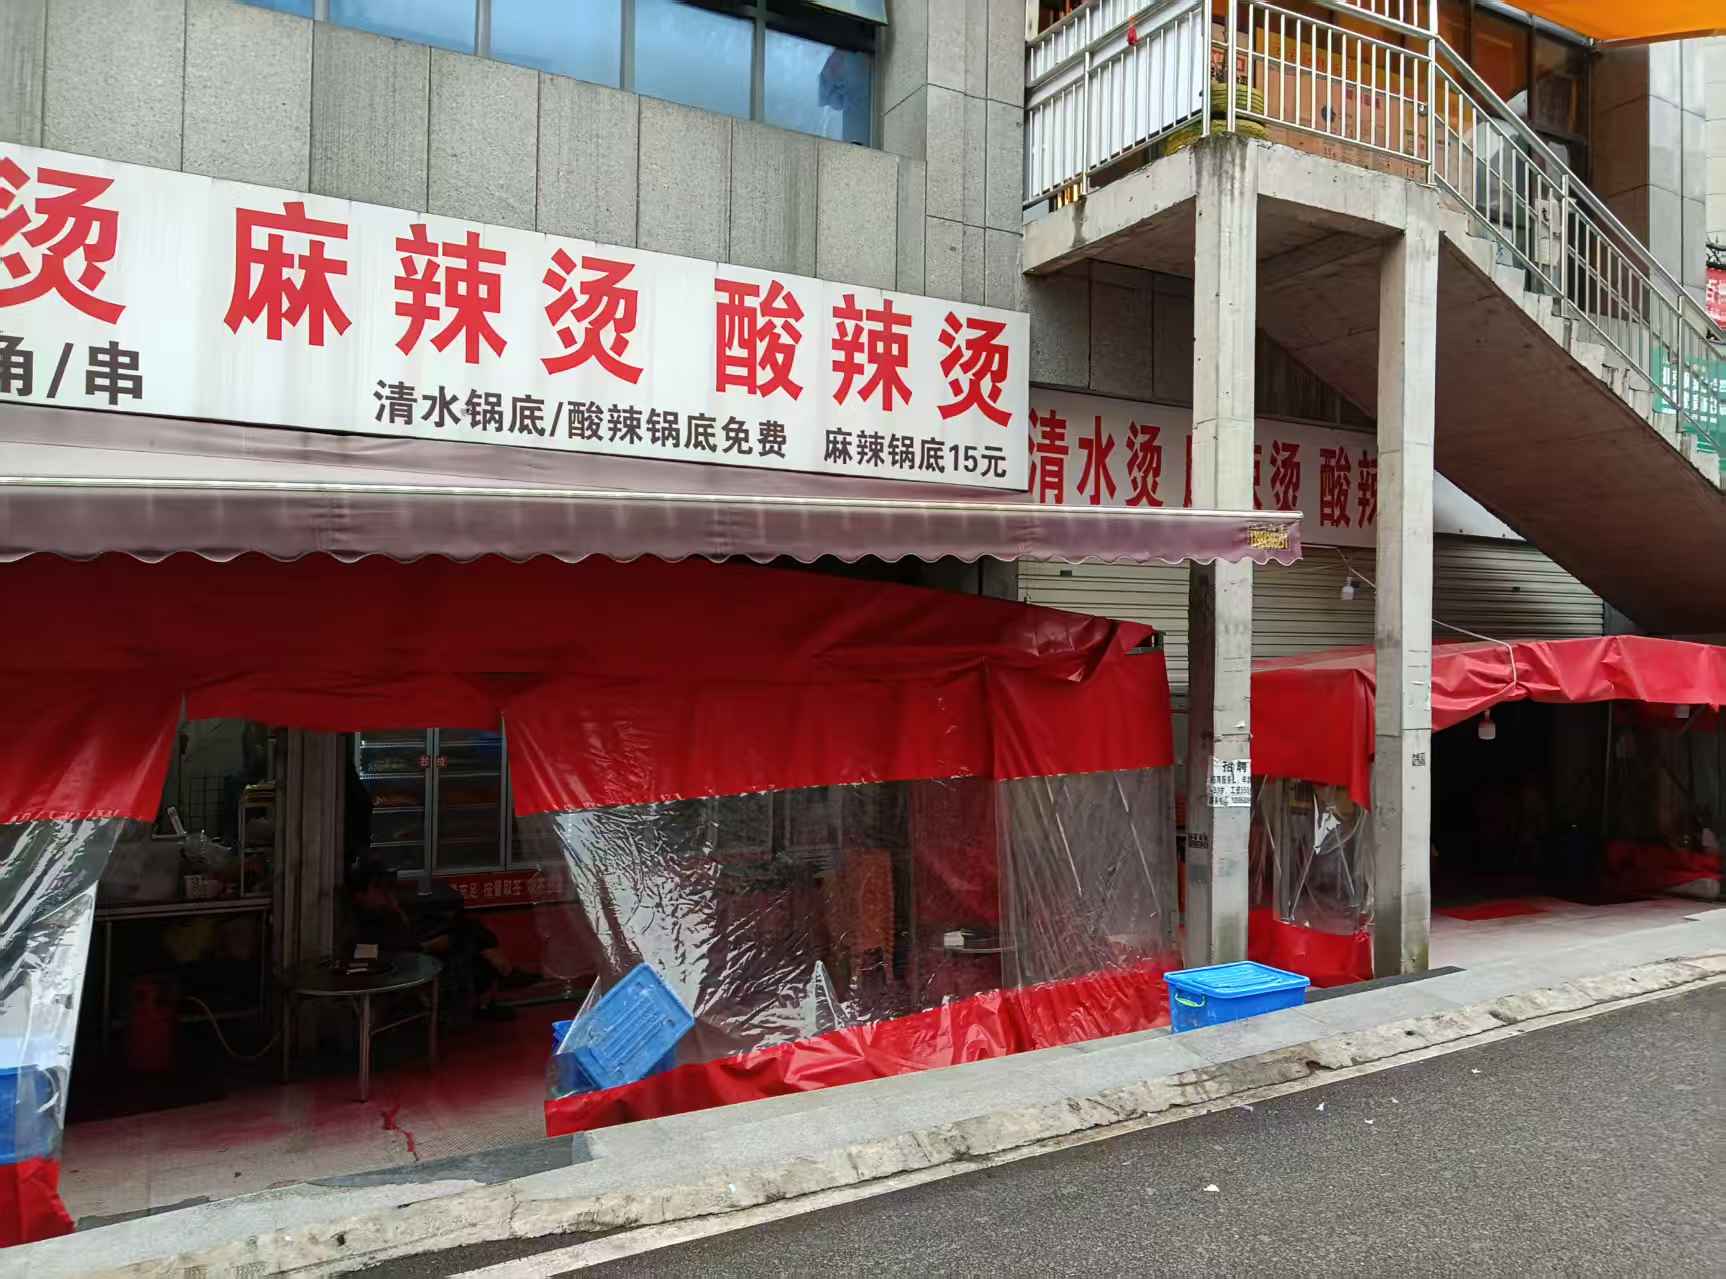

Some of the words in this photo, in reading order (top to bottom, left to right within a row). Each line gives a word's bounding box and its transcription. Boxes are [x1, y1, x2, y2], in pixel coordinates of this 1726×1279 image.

[0, 156, 126, 325] 烫
[223, 201, 644, 384] 麻辣烫
[714, 278, 1013, 428] 酸辣烫
[373, 380, 788, 459] 清水锅底/酸辣锅底免费
[824, 427, 1008, 479] 麻辣锅底15元
[1029, 407, 1164, 508] 清水烫
